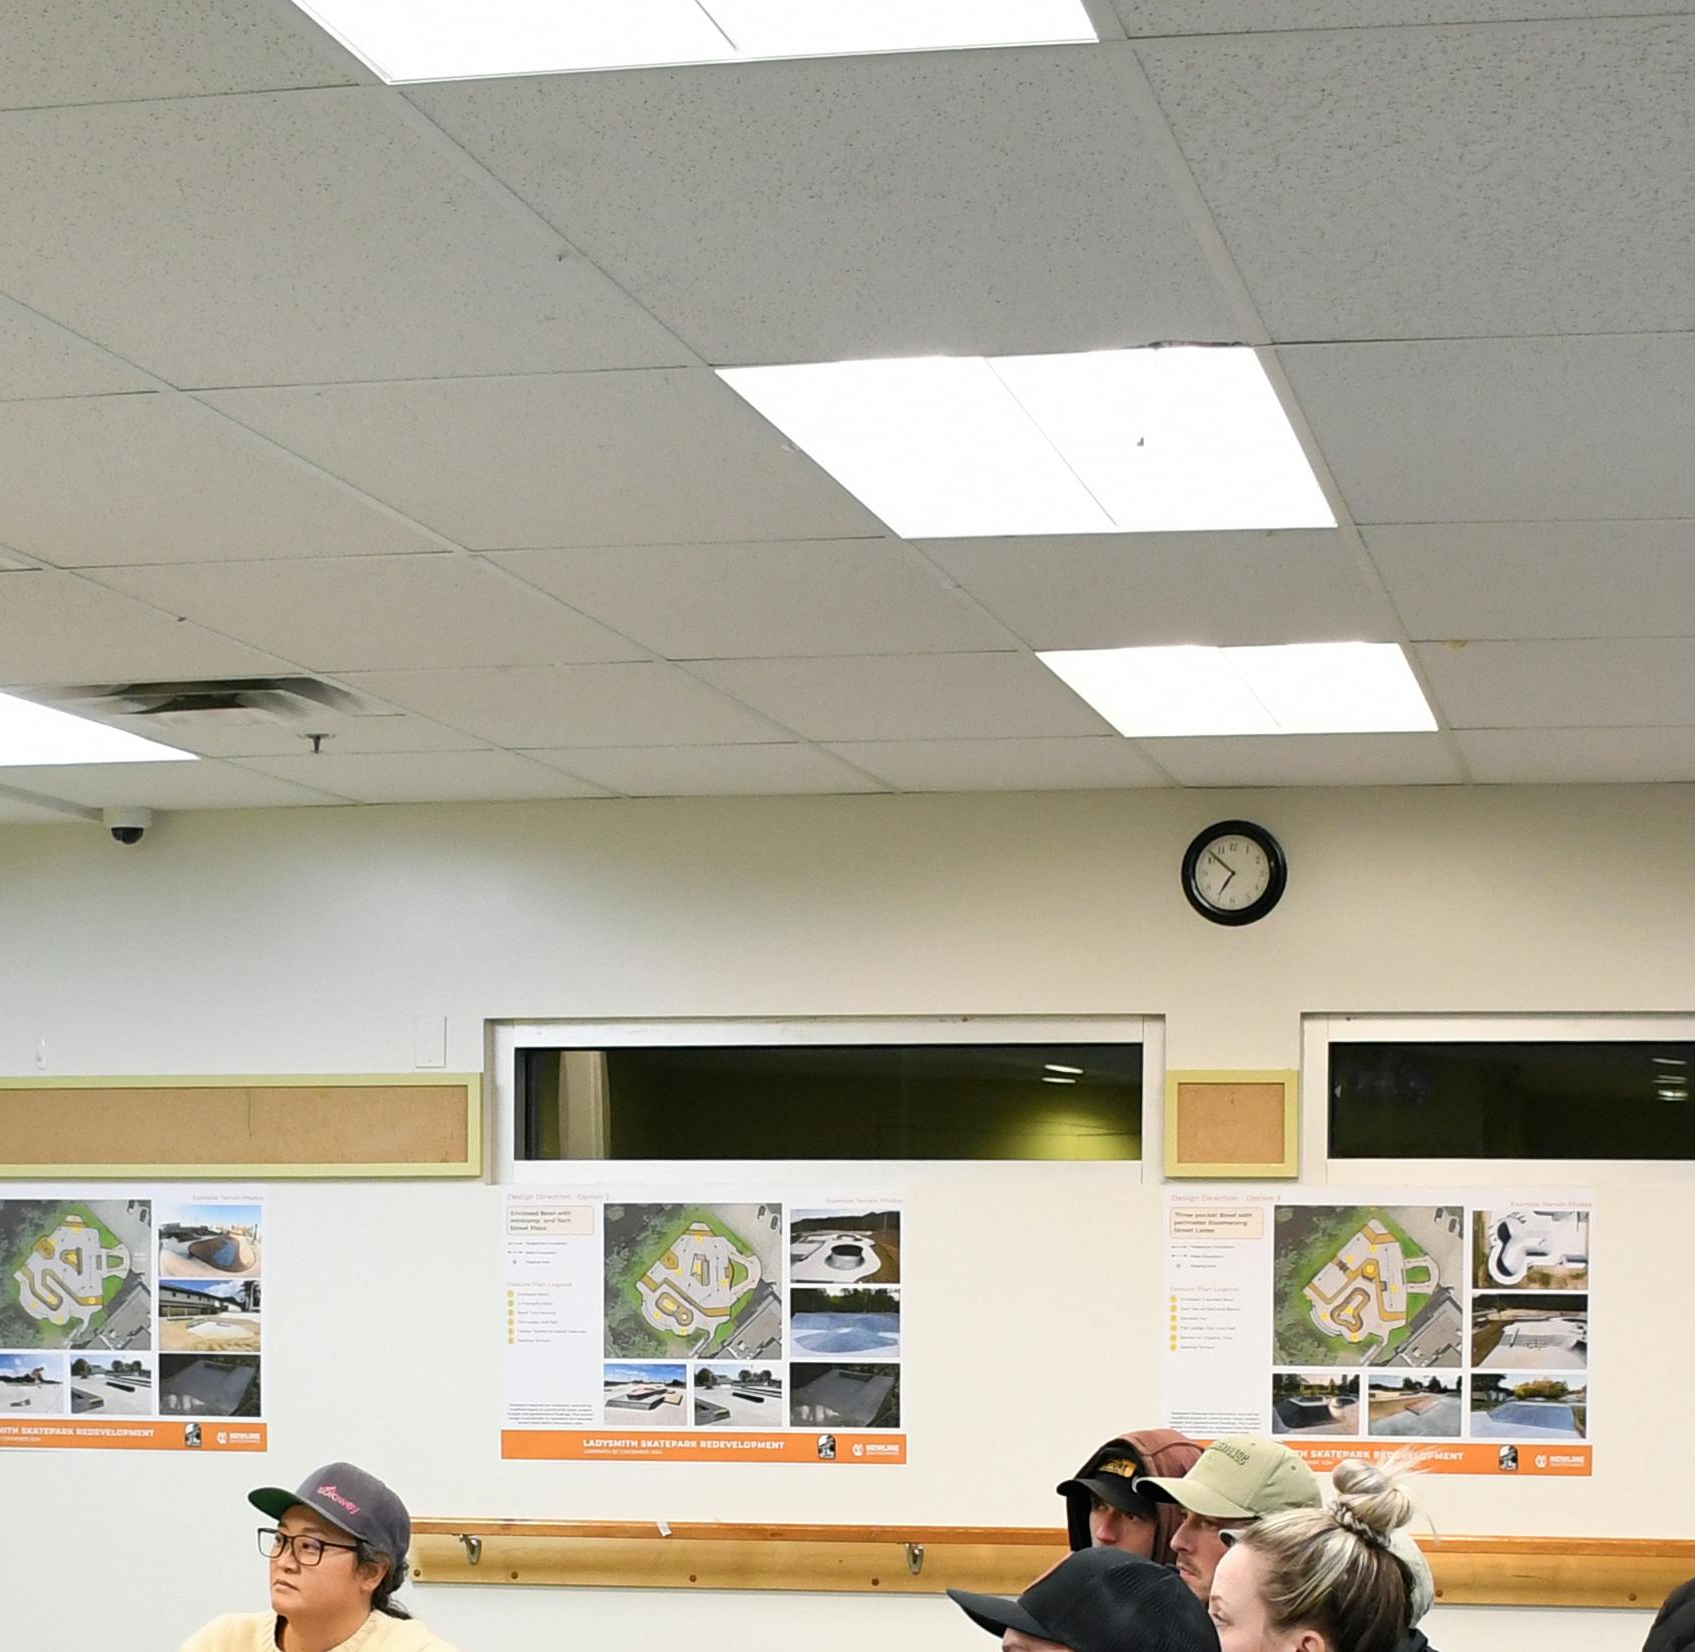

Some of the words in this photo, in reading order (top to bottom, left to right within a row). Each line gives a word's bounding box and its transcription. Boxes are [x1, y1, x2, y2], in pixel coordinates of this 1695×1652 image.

[21, 1427, 74, 1436] SKATEPARK
[76, 1428, 154, 1437] REDEVELOPMENT
[583, 1439, 638, 1448] LADYSMITH
[641, 1440, 696, 1449] SKATEPARK
[700, 1441, 785, 1450] REDEVELOPMENT
[1310, 1450, 1370, 1459] SKATEPARK
